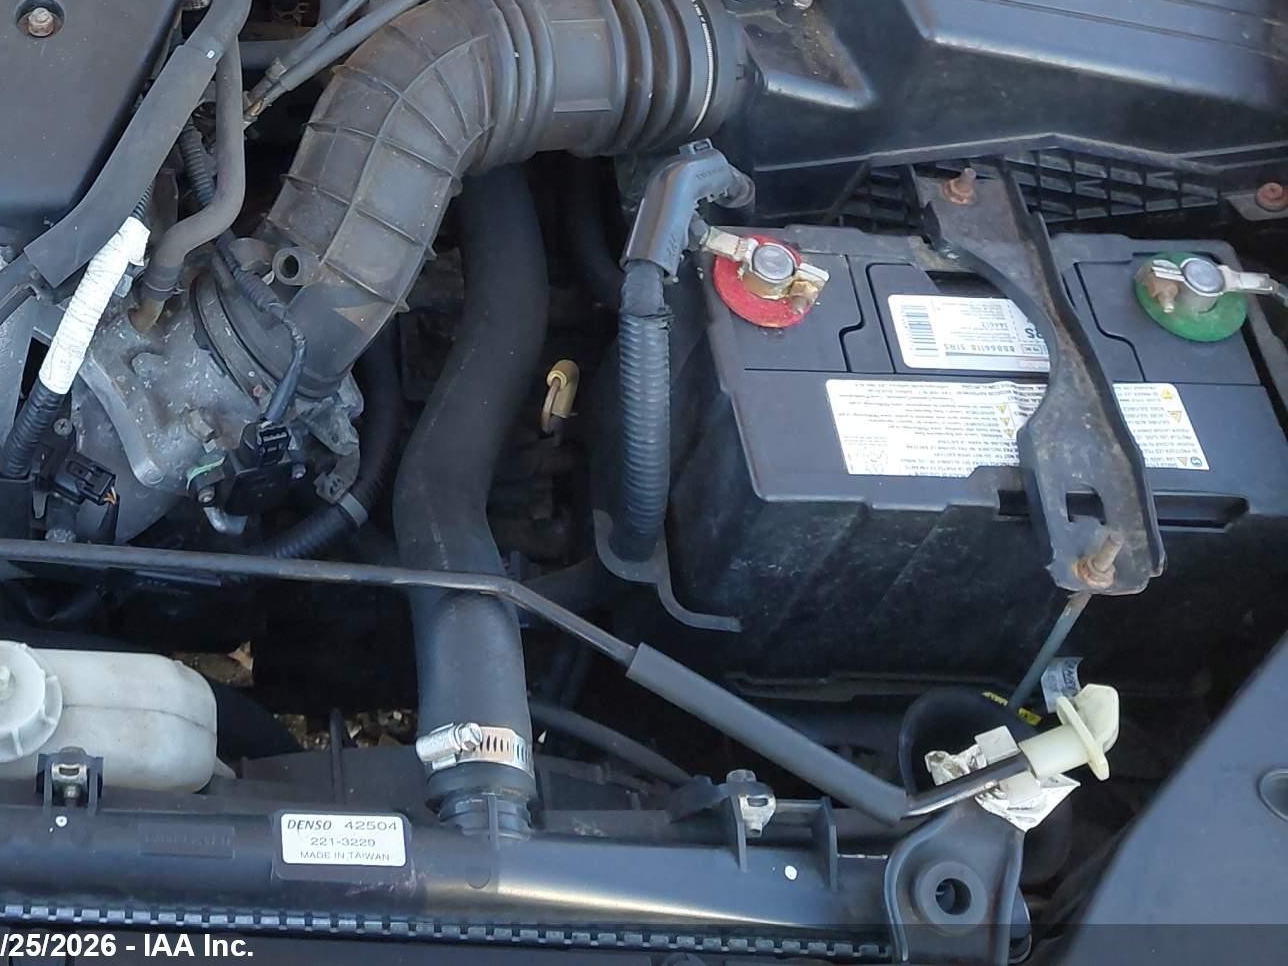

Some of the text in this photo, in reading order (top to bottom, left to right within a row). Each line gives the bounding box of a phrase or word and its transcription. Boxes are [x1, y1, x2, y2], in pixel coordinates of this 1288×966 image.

[287, 819, 397, 831] DENSO 42504
[310, 837, 376, 847] 221-3229
[300, 850, 390, 862] MADE IN TAIWAN
